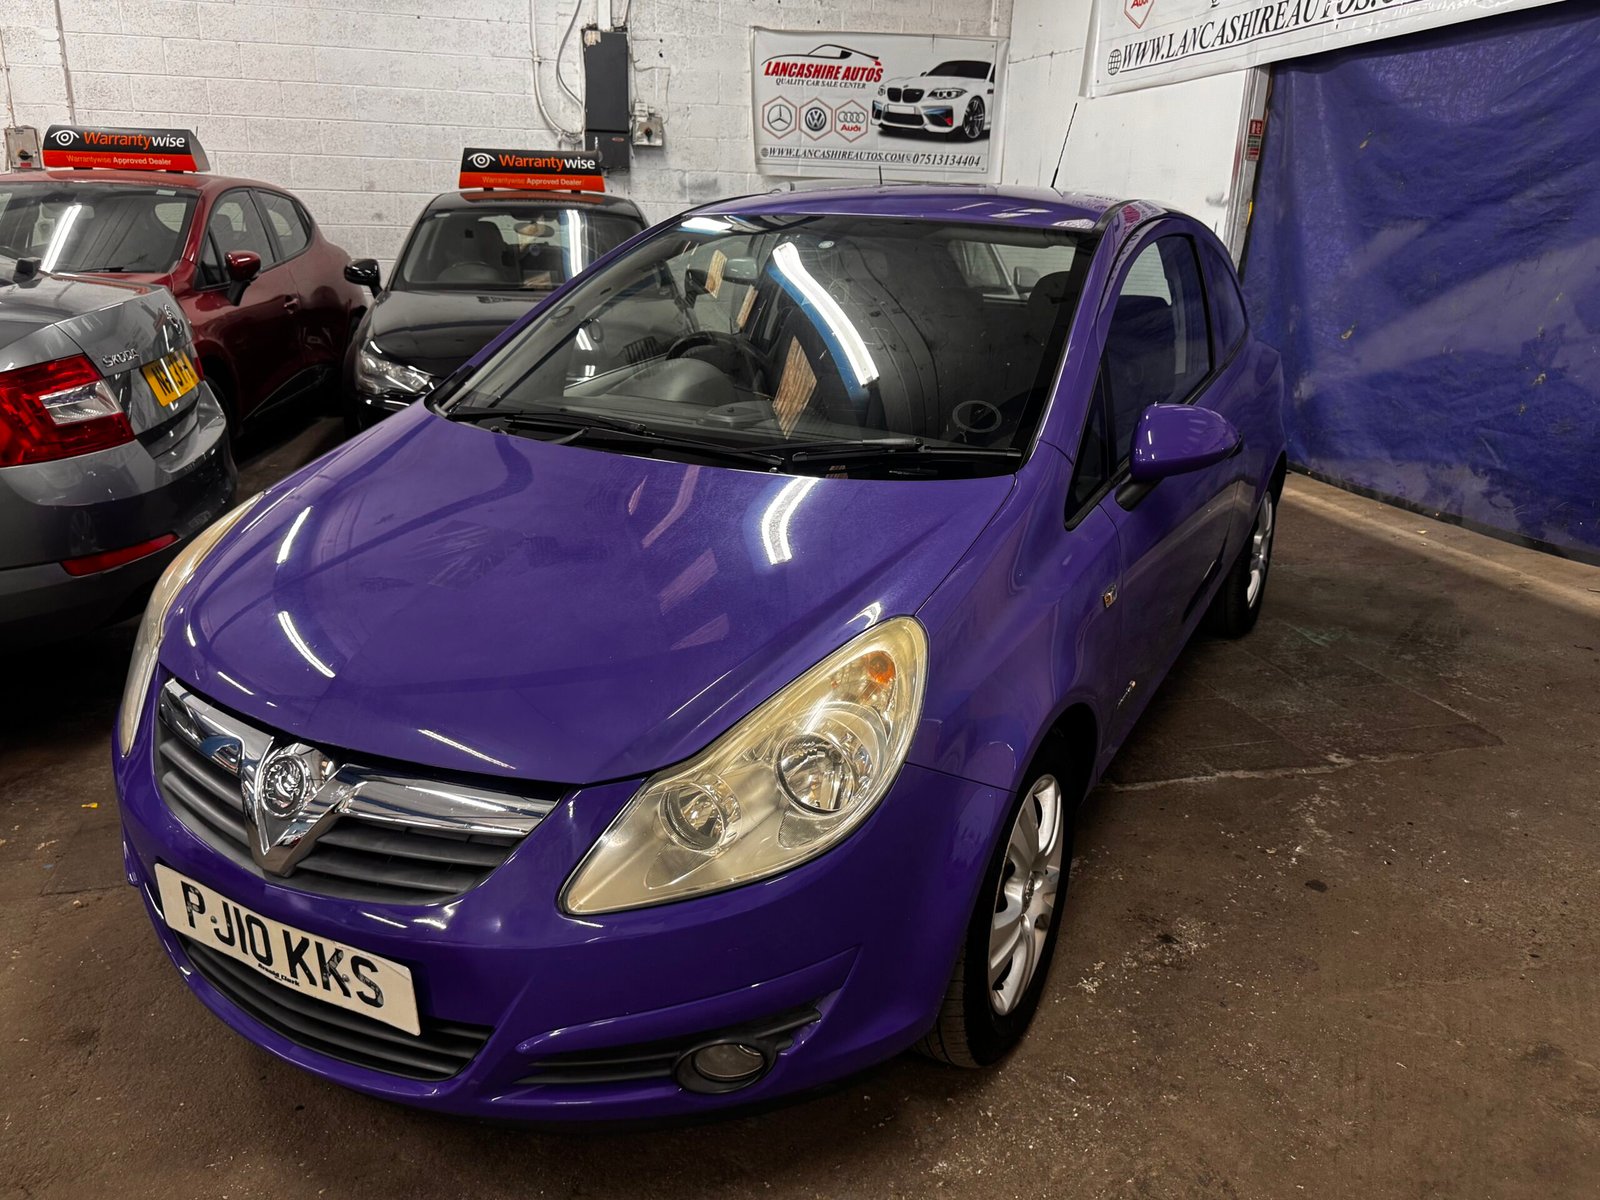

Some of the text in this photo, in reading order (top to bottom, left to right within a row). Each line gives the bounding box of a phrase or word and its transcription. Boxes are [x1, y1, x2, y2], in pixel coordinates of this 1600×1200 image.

[764, 61, 884, 83] LANCASHIRE AUTOS
[775, 77, 867, 90] QUALITY CAR SALE CENTER
[840, 124, 862, 132] Audi
[83, 131, 186, 150] Warrantywise
[113, 156, 148, 166] Approved
[148, 157, 172, 166] Dealer
[498, 154, 596, 172] Warrantywise
[769, 146, 981, 167] WWW.LANCASHIREAUTOS.COM 07513134404
[526, 177, 560, 186] Approved
[560, 178, 582, 186] Dealer
[180, 880, 385, 1009] PJ10 KKS
